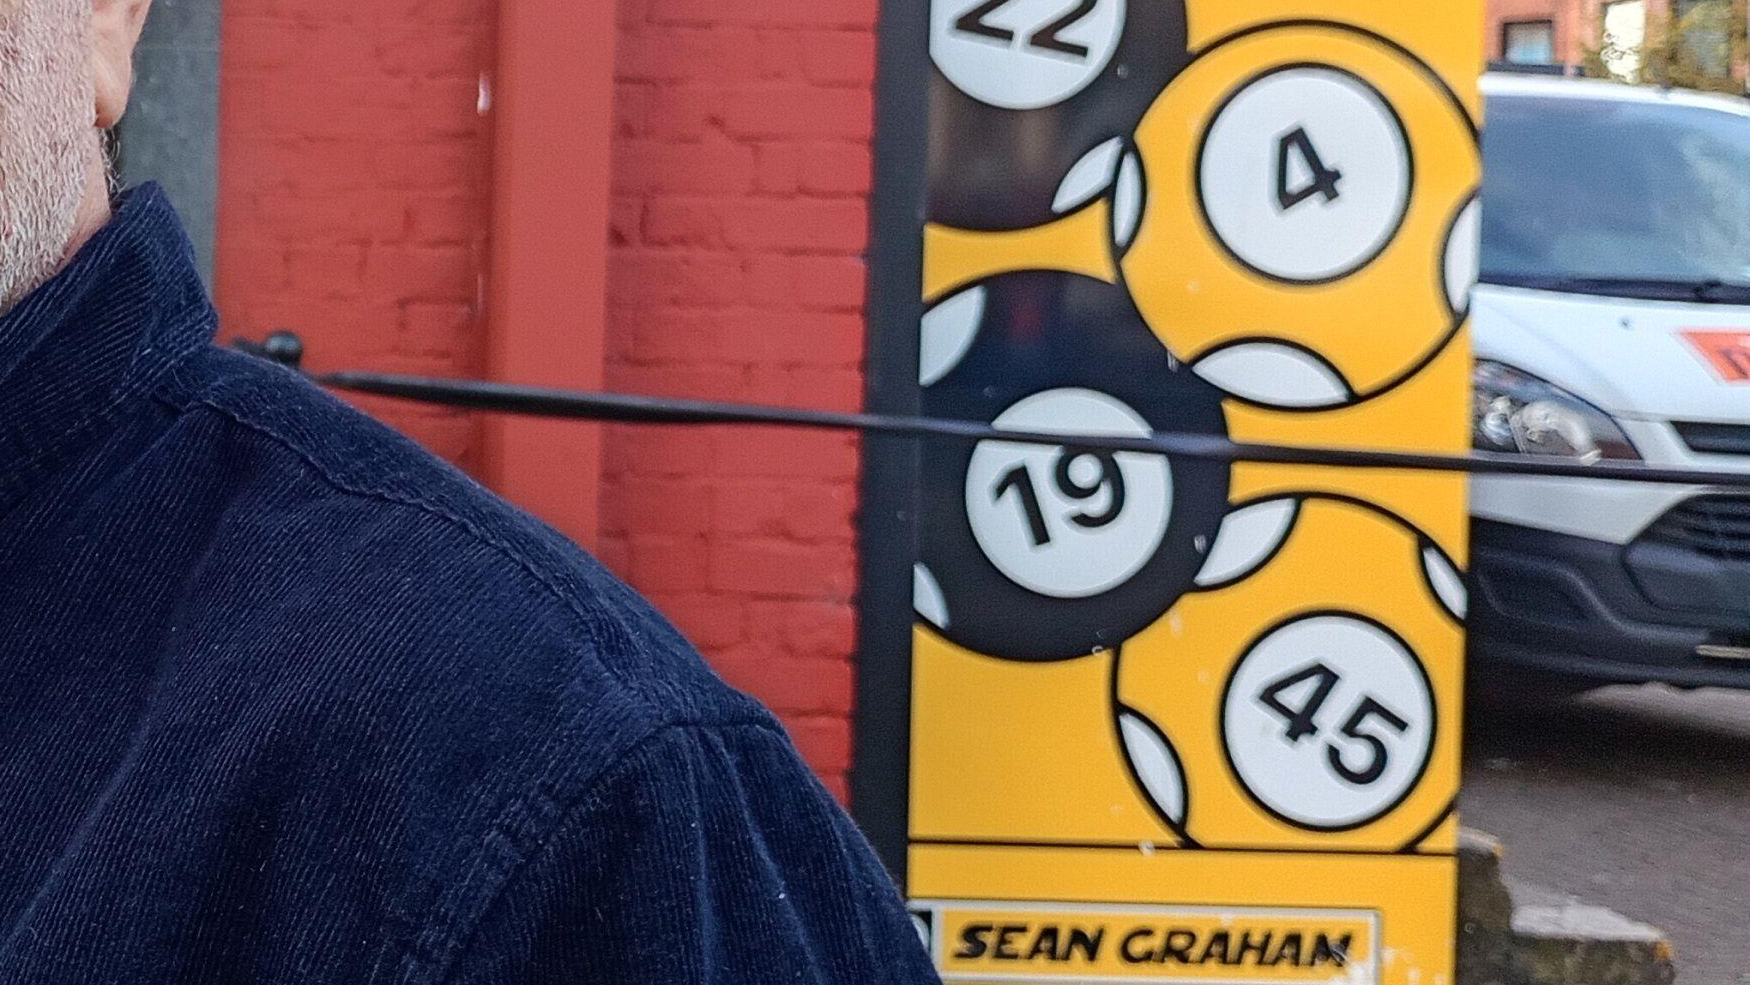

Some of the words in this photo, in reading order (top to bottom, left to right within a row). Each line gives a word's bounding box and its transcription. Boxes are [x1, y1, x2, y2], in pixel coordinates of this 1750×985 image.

[1273, 125, 1342, 212] 4
[993, 446, 1124, 548] 19
[1258, 662, 1409, 784] 45
[956, 924, 1108, 963] SEAN
[1120, 927, 1354, 968] GRAHAM
